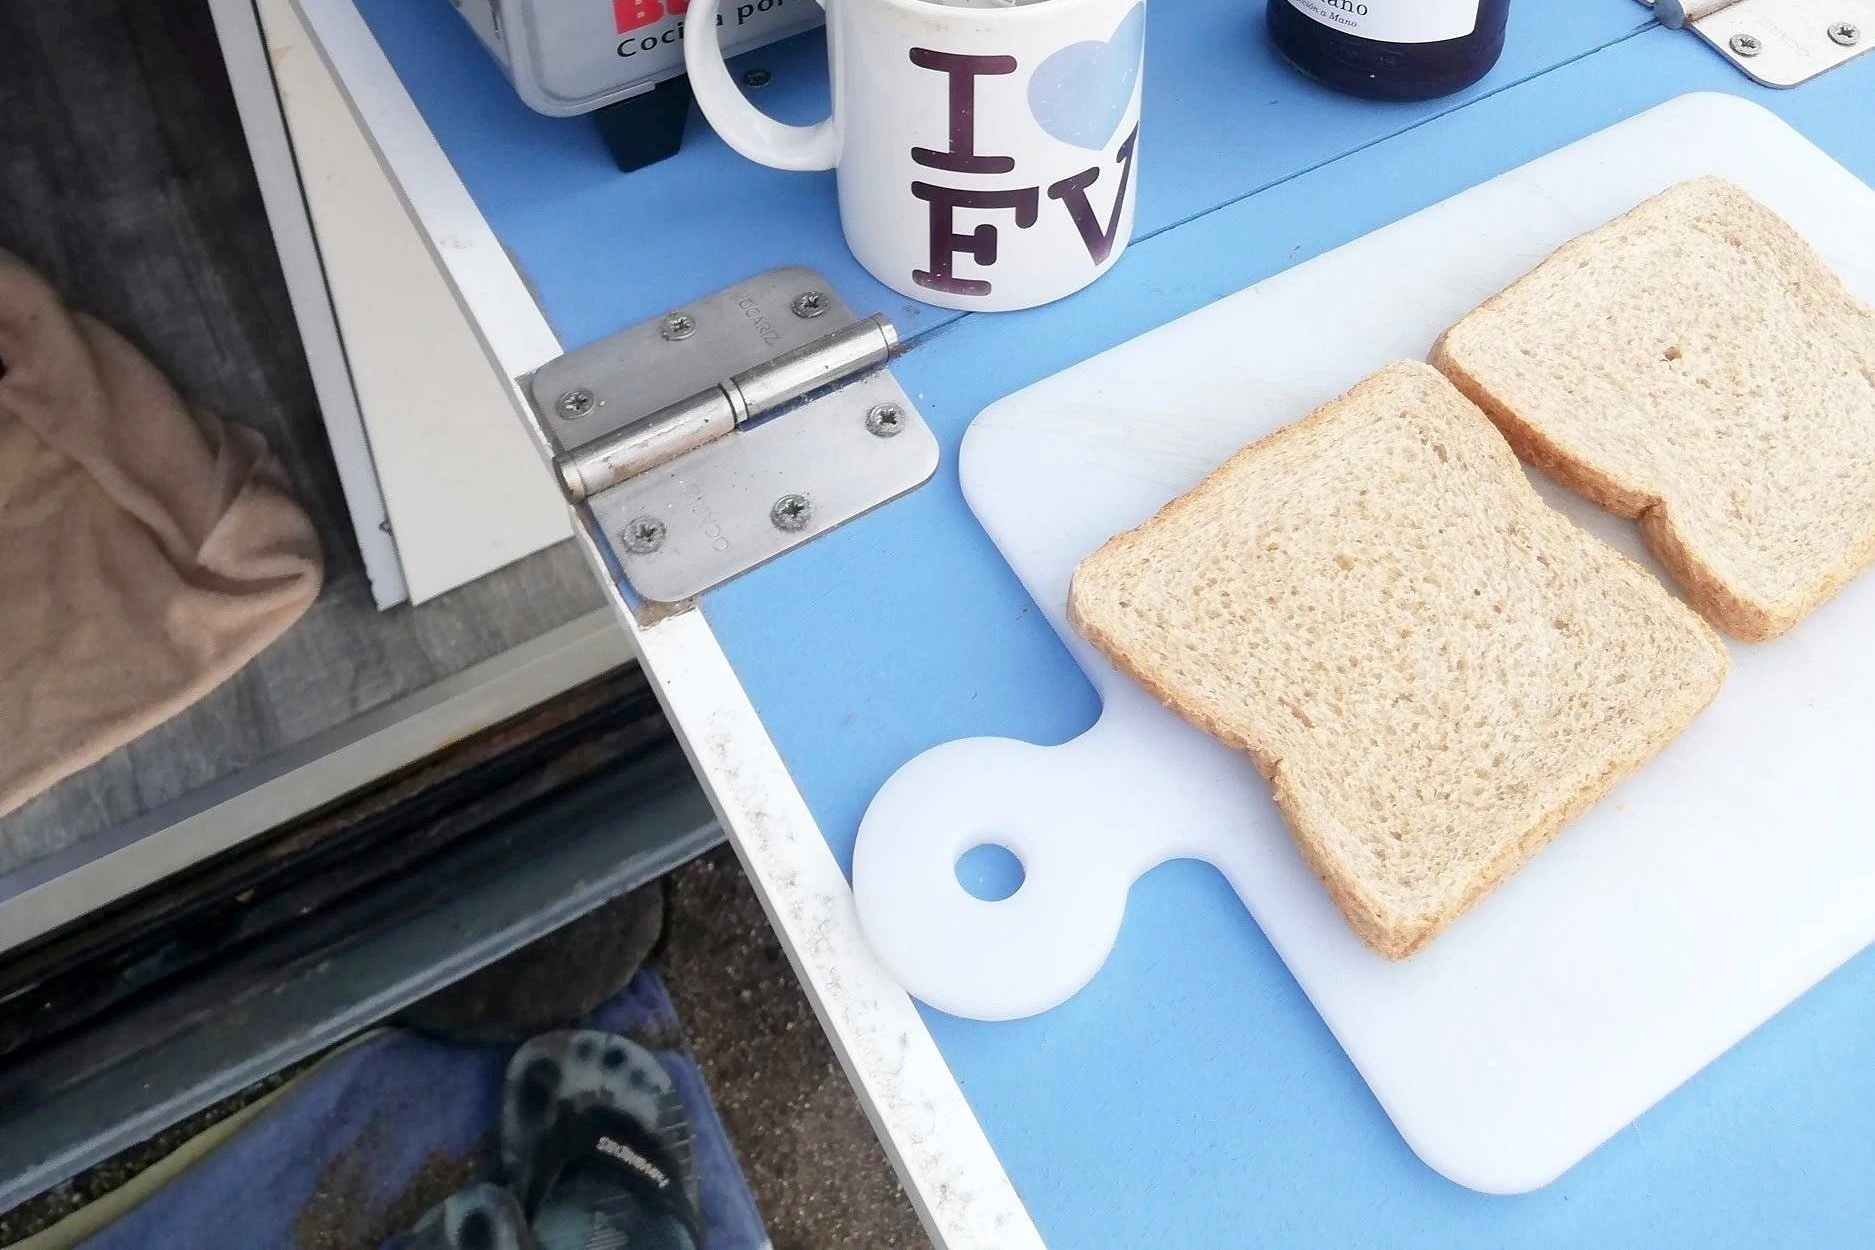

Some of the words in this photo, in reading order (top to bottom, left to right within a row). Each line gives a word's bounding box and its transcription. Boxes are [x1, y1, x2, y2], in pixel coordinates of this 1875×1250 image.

[616, 14, 724, 58] Cocia
[1328, 12, 1358, 28] Mano
[909, 47, 1018, 175] I
